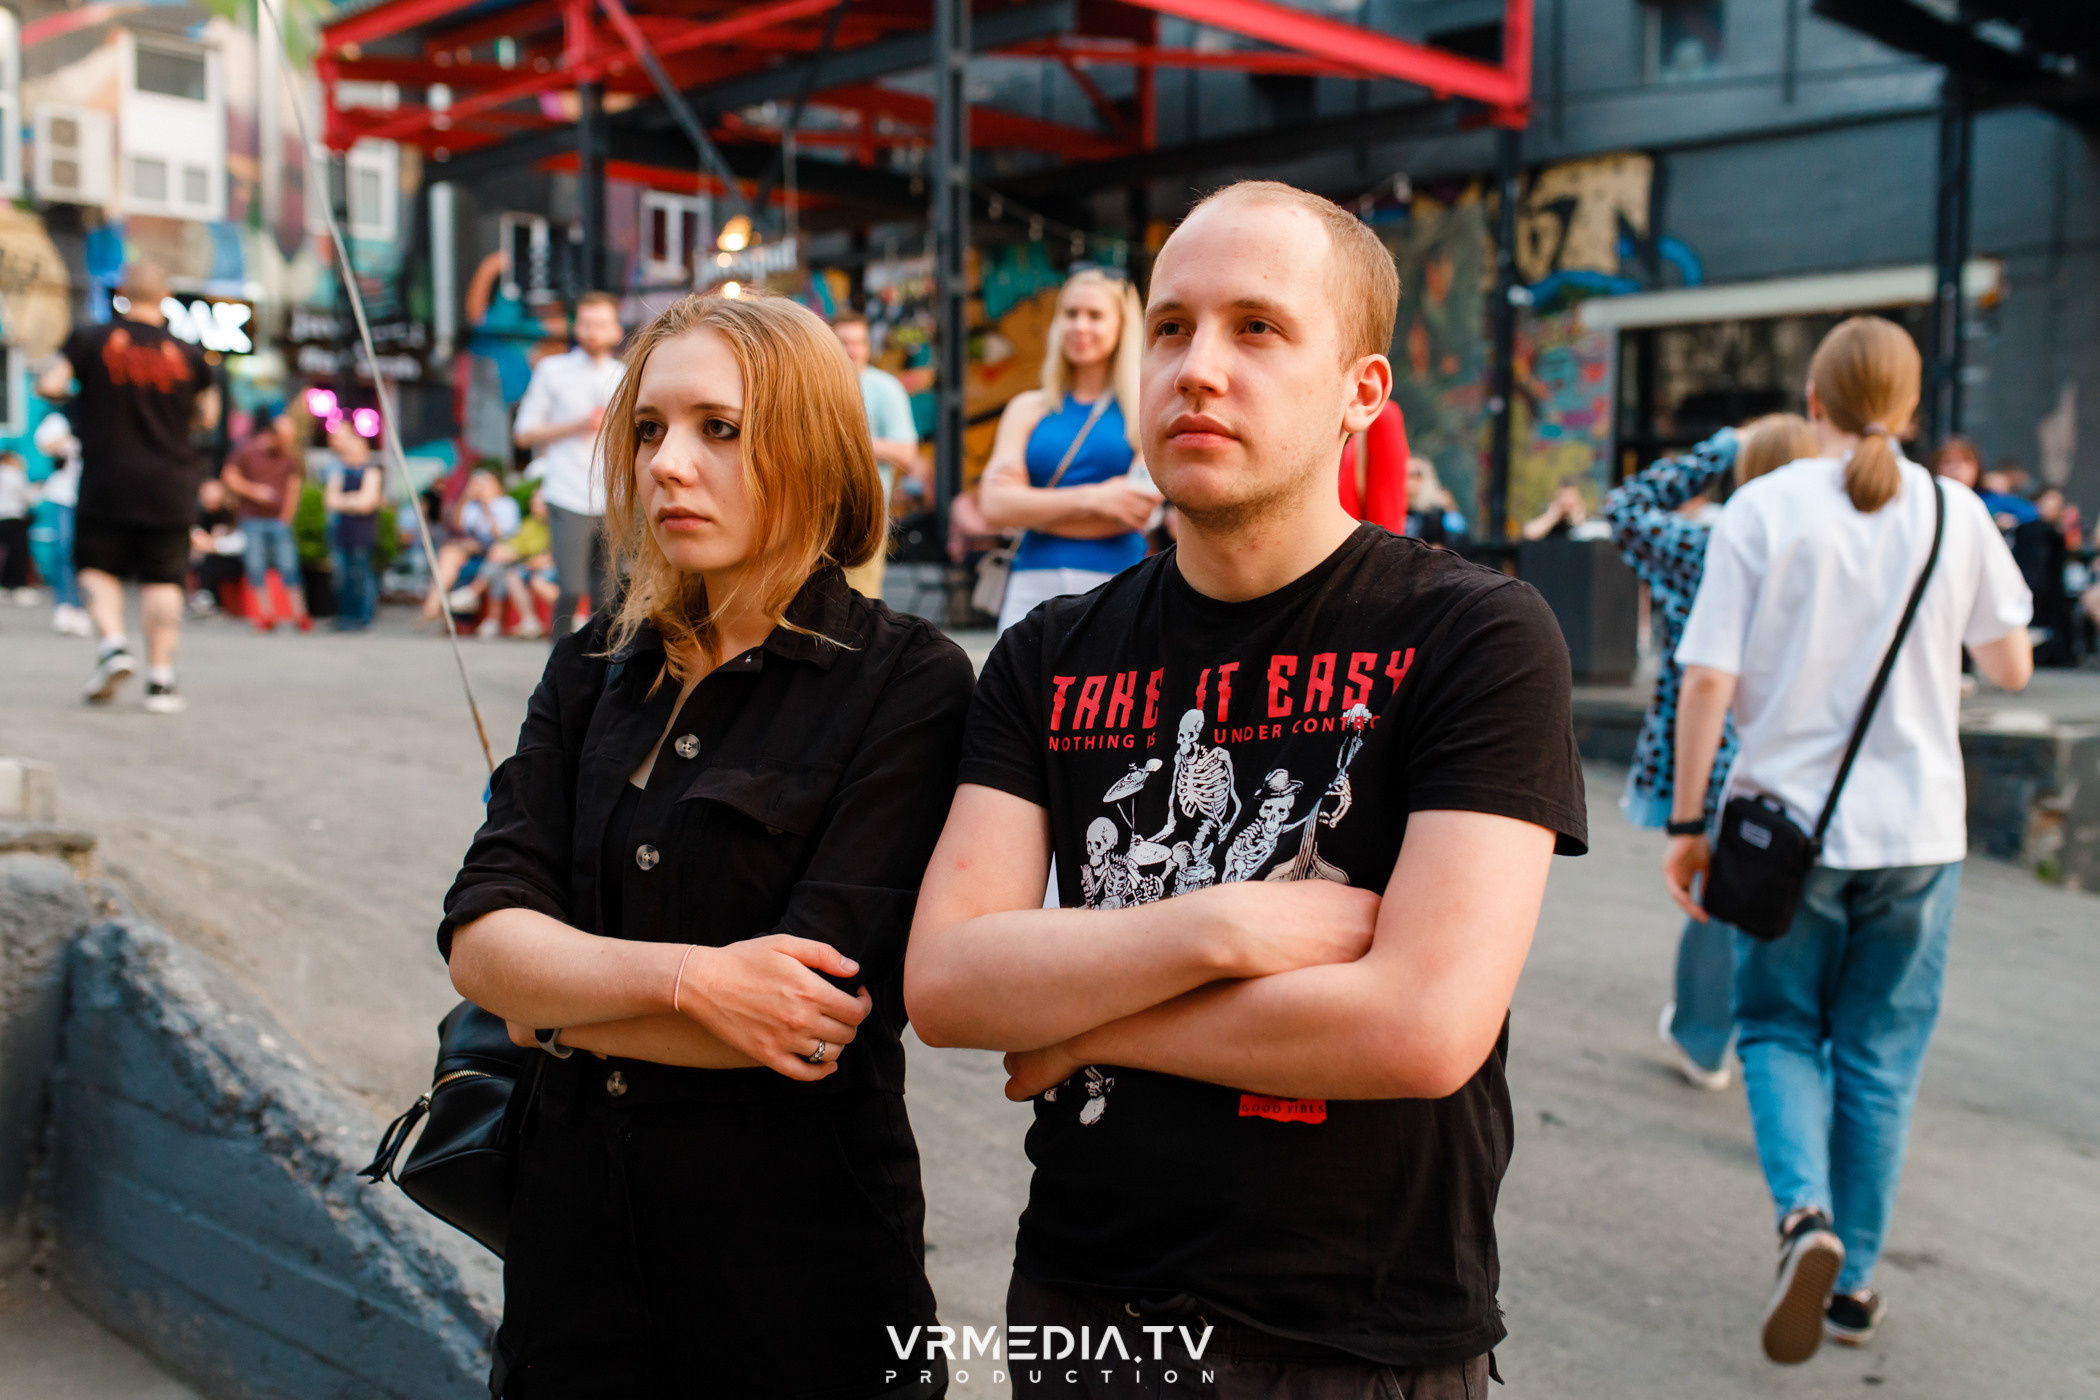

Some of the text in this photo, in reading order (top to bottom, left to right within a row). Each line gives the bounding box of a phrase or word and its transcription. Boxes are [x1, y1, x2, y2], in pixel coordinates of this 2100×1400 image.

[1050, 648, 1416, 731] TAKE IT EASY
[1049, 734, 1135, 751] NOTHING
[1213, 724, 1282, 744] UNDER
[1241, 1103, 1325, 1114] GOOD VIBES
